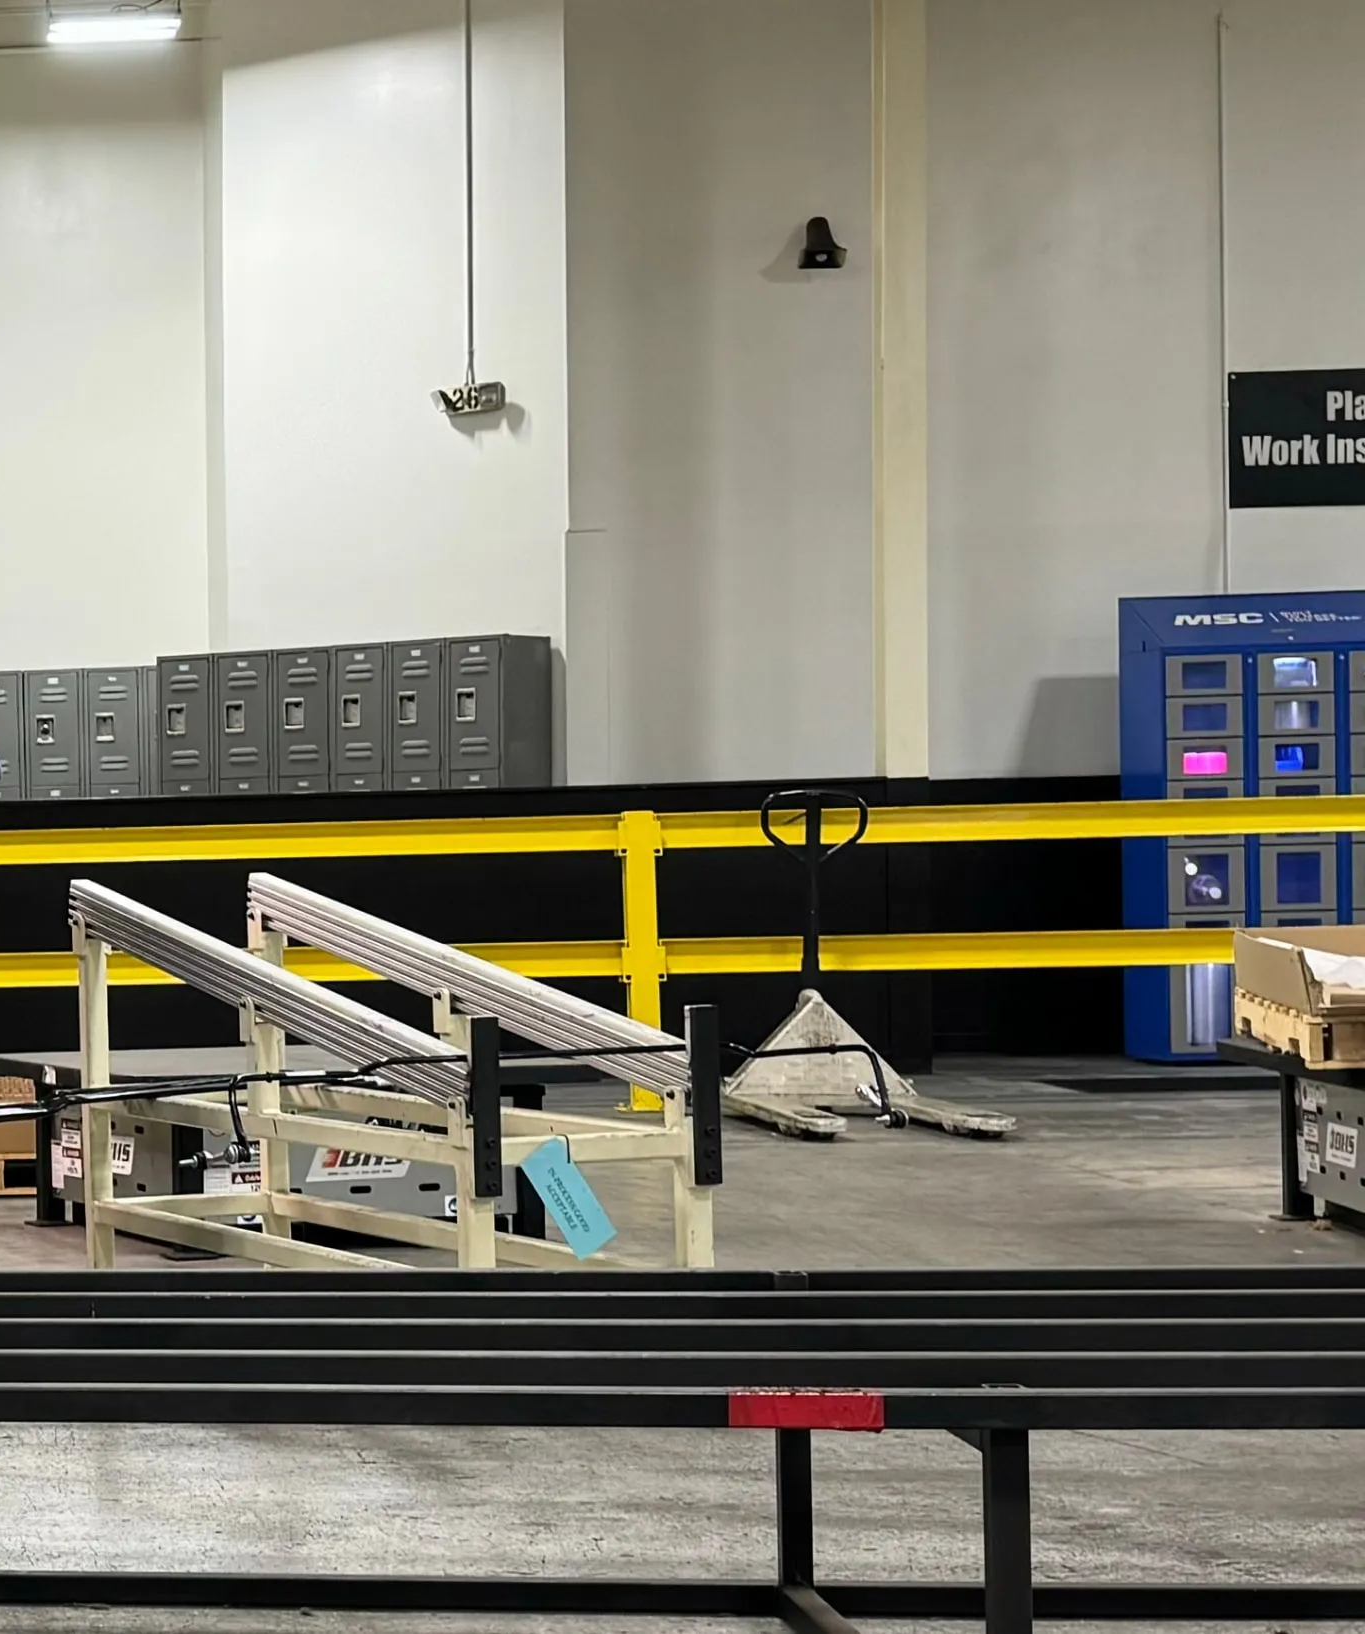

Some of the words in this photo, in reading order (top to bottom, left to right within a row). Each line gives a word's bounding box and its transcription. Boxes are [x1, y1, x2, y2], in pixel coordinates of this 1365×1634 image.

[1326, 390, 1365, 421] Pla
[1242, 434, 1320, 466] Work
[1327, 433, 1365, 464] Ins
[1174, 612, 1265, 626] MSC
